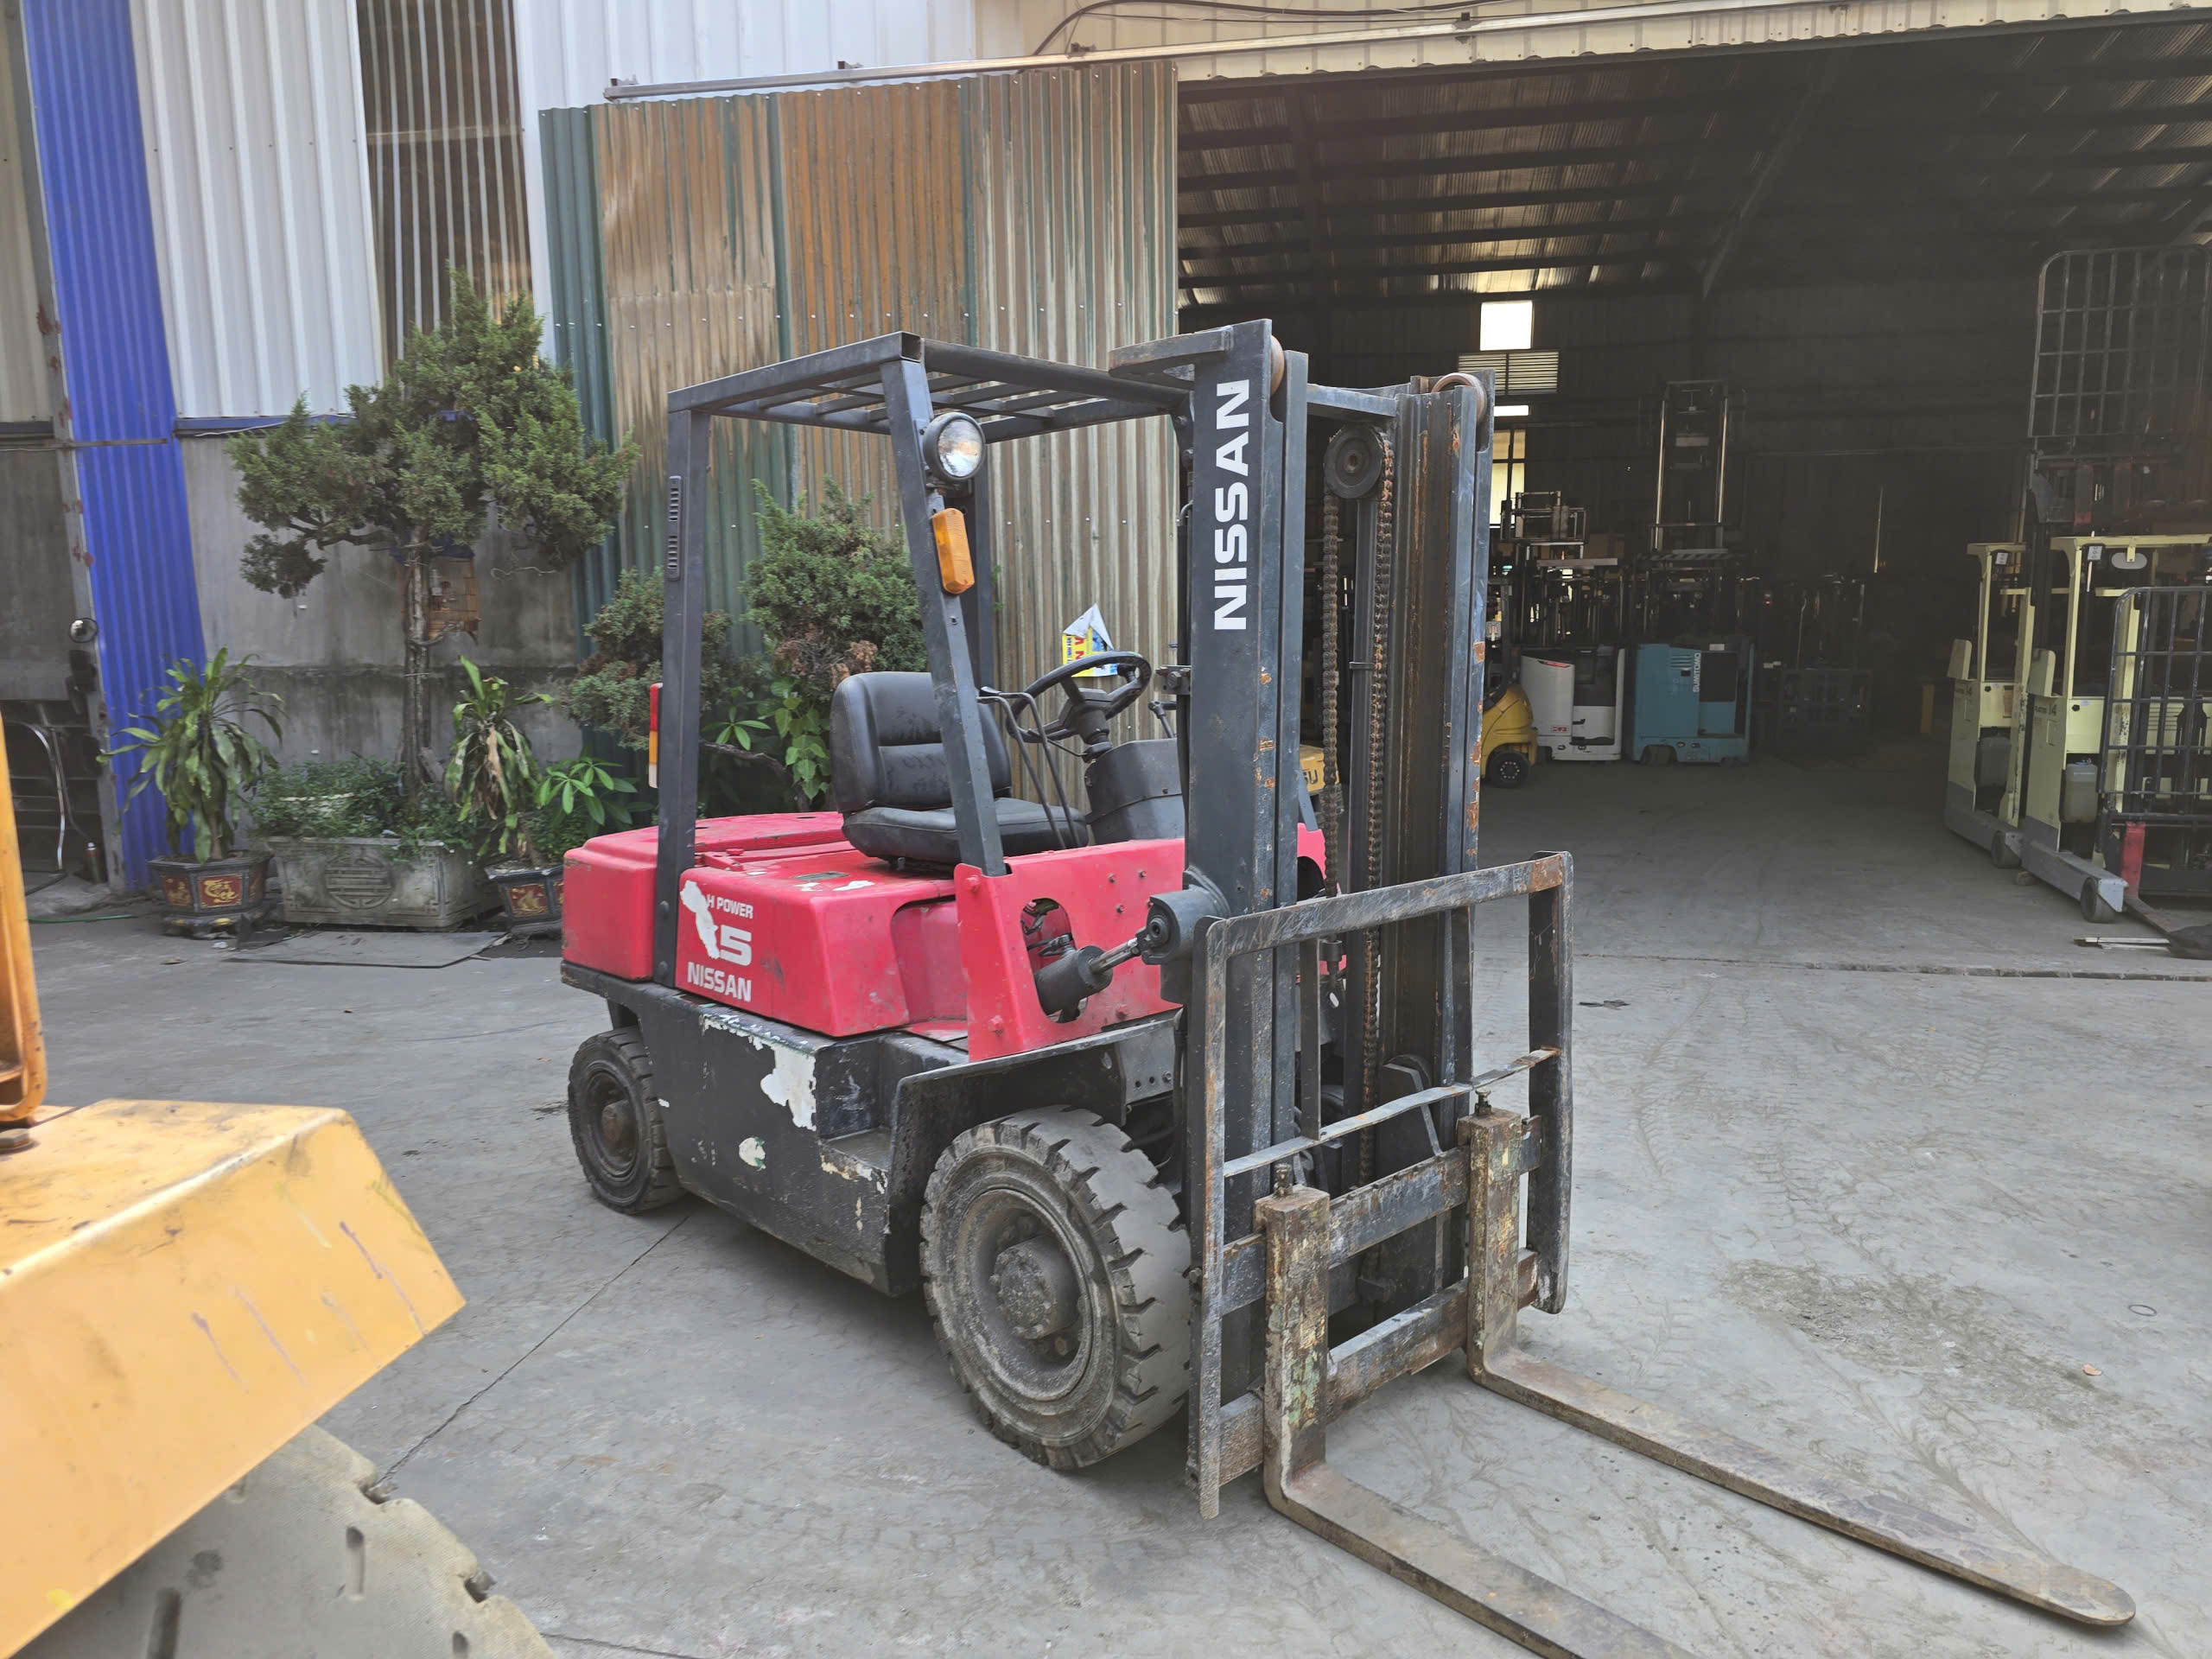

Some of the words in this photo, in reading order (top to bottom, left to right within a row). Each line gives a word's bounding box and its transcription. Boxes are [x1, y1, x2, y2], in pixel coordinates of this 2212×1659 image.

[1214, 378, 1250, 630] NISSAN
[1693, 652, 1701, 692] SUMITOMO
[716, 896, 753, 919] POWER
[687, 962, 752, 1002] NISSAN
